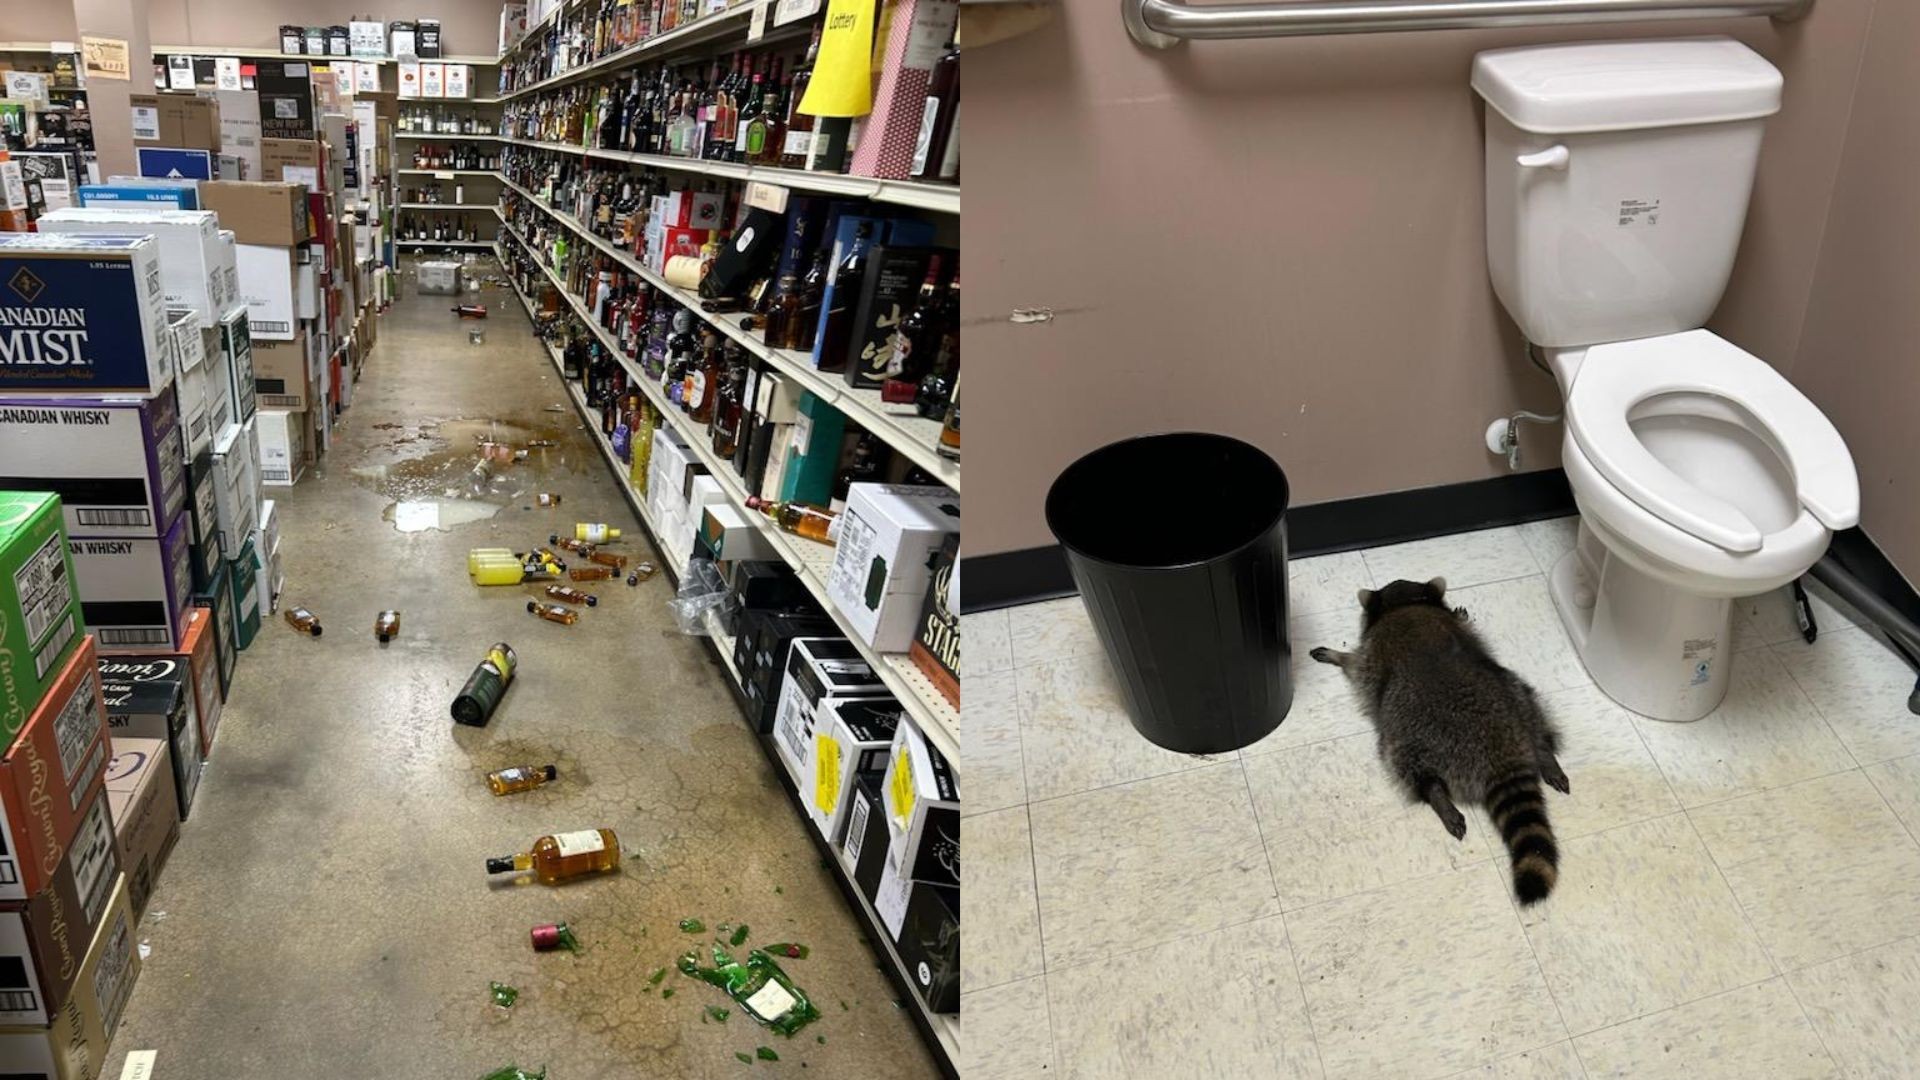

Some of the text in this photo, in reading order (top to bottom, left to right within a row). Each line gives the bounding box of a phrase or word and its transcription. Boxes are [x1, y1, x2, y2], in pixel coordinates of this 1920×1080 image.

[829, 13, 857, 32] Lottery
[263, 120, 284, 129] NEW
[60, 410, 110, 425] WHISKY
[86, 541, 133, 554] WHISKY
[923, 613, 960, 678] STAG
